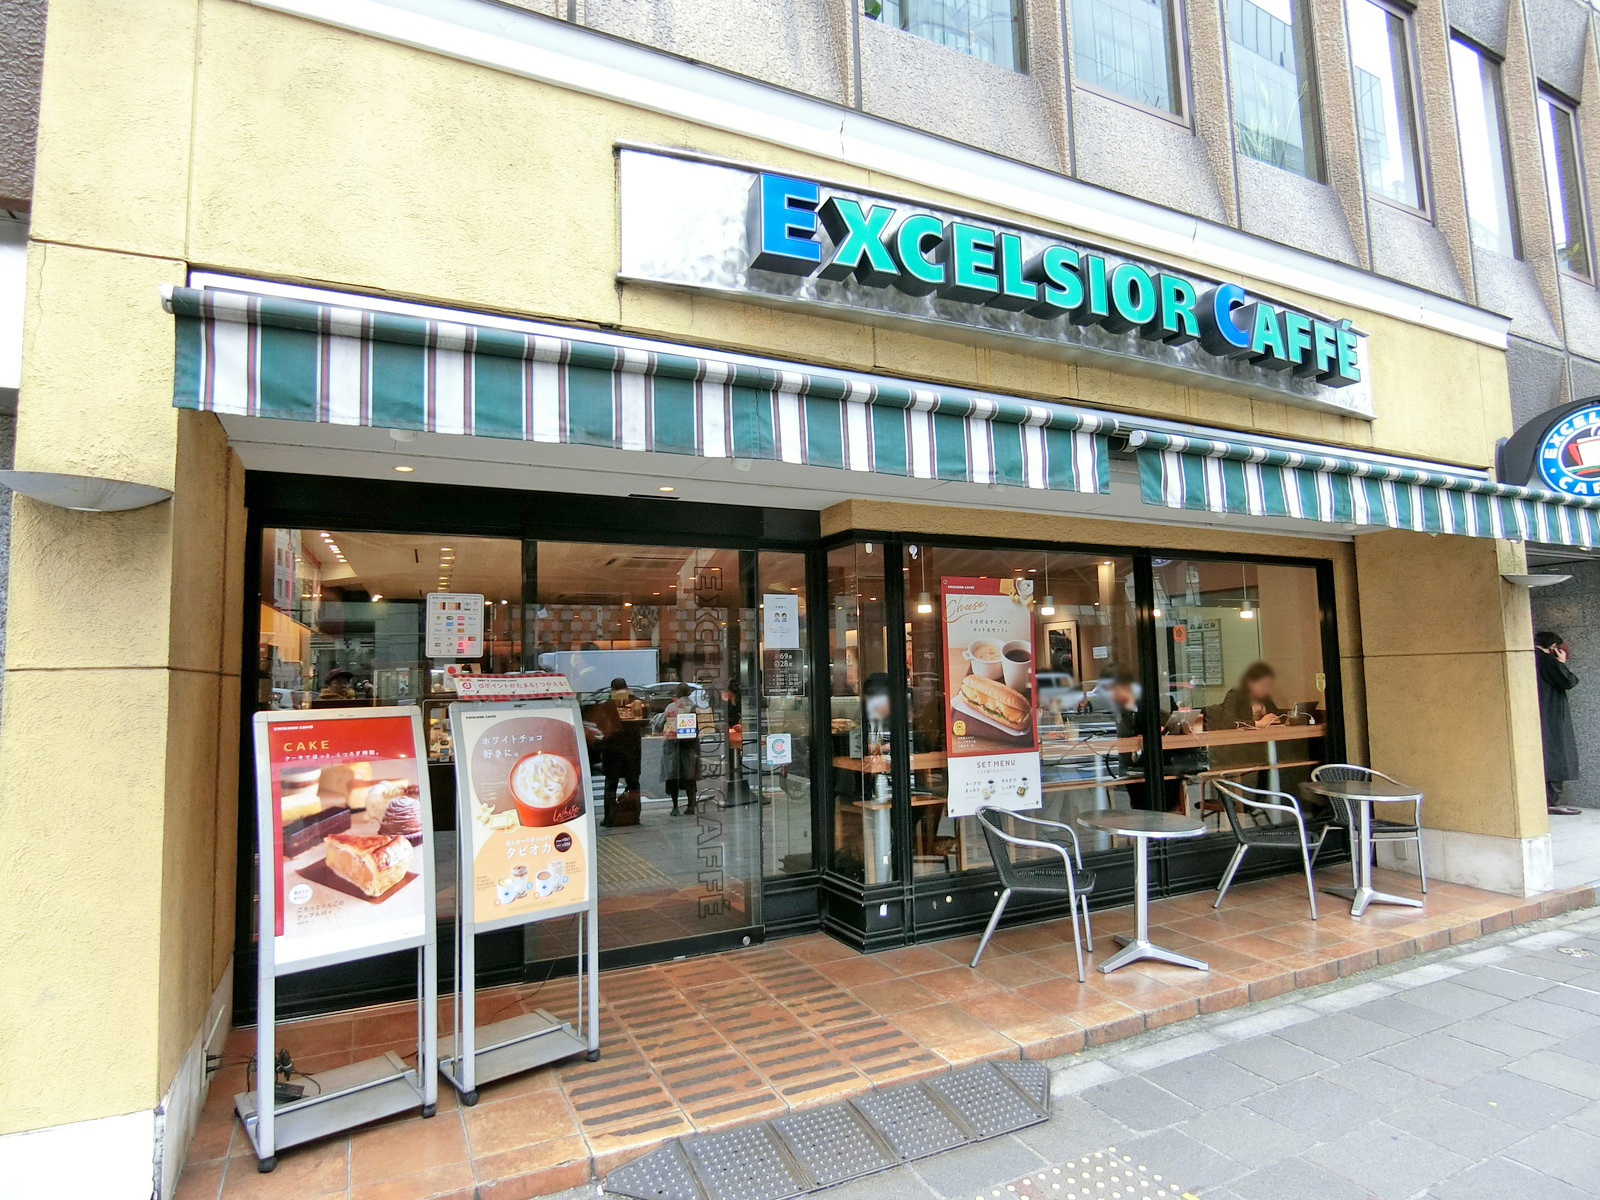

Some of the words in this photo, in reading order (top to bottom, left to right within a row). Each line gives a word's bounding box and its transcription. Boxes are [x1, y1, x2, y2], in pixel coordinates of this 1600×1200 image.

[757, 171, 1201, 340] EXCELSIOR
[1210, 282, 1361, 384] CAFFÉ
[944, 594, 987, 621] Cheese
[283, 739, 331, 752] CAKE
[481, 734, 544, 746] ホワイトチョコ
[483, 749, 520, 760] 好きに。
[976, 761, 991, 769] SET
[993, 759, 1016, 768] MENU
[696, 786, 731, 919] CAFFÉ
